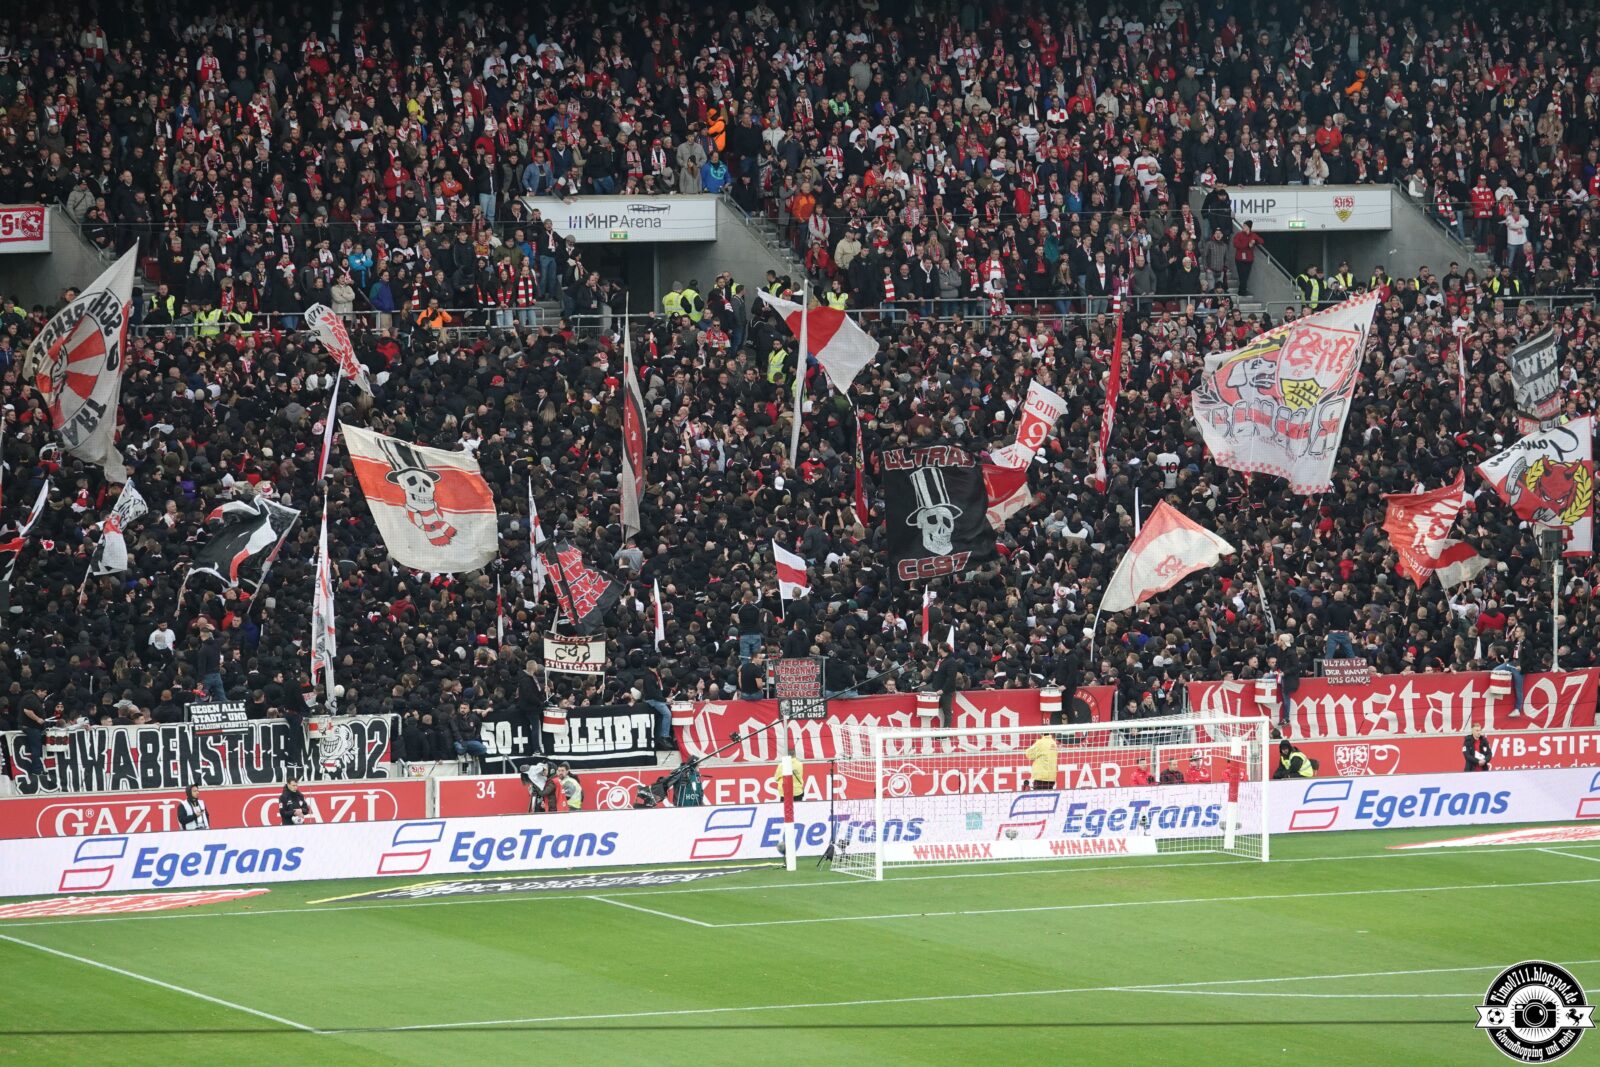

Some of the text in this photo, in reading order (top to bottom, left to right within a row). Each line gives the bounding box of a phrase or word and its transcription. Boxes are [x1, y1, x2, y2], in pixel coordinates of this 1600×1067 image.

[1241, 199, 1276, 214] MHP
[585, 215, 661, 229] MHP Arena
[882, 445, 976, 471] ULTRAS
[1166, 462, 1177, 473] 10
[898, 551, 972, 581] CC97
[545, 660, 602, 671] STUTTGART
[1323, 659, 1350, 667] ULTRA
[1328, 676, 1343, 684] UMS
[190, 702, 246, 714] GEGEN ALLE
[1523, 675, 1589, 729] 97
[192, 712, 248, 723] STADT- UND
[554, 713, 655, 753] BLEIBT!
[476, 781, 496, 799] 34
[1355, 786, 1510, 827] EgeTrans
[1063, 800, 1222, 837] EgeTrans
[450, 828, 618, 870] EgeTrans
[912, 842, 992, 860] WINAMAX
[1050, 838, 1129, 856] WINAMAX
[132, 843, 304, 886] EgeTrans
